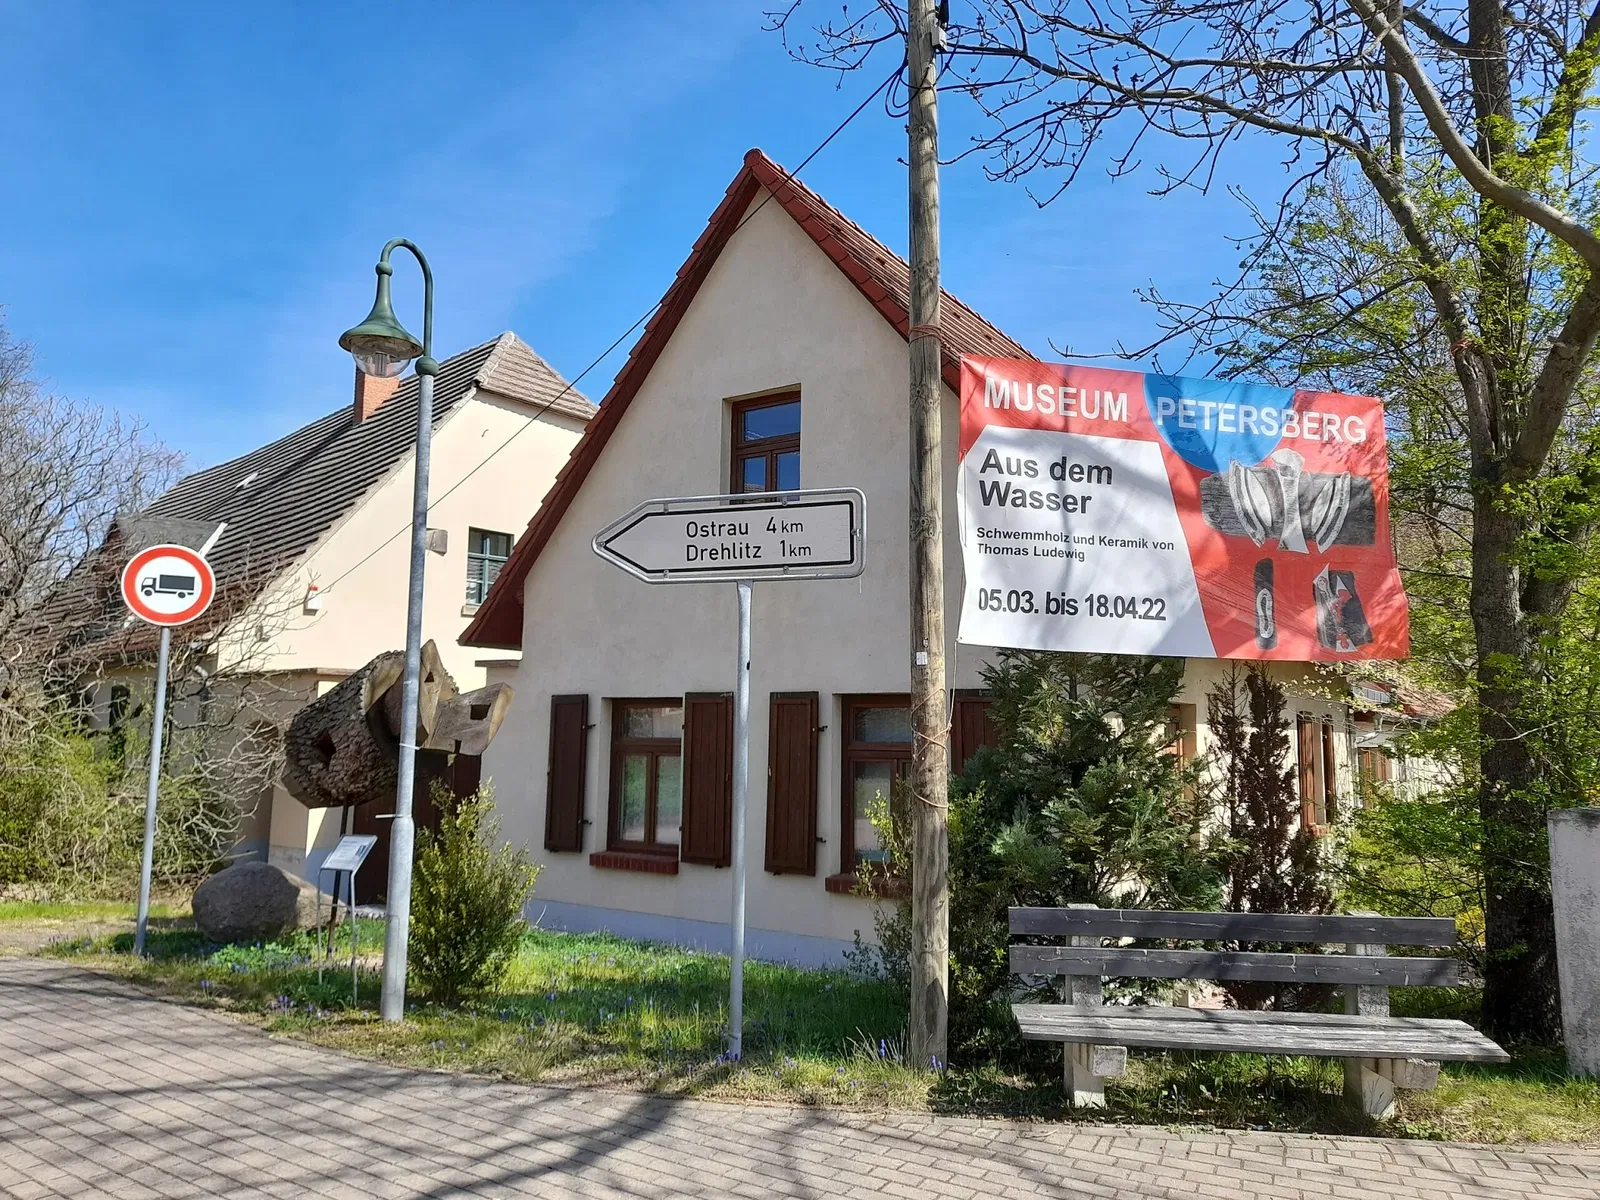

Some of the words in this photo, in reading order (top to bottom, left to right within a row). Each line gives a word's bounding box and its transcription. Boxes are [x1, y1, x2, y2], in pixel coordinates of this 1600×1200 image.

[984, 376, 1128, 423] MUSEUM
[1156, 396, 1367, 444] PETERSBERG
[979, 448, 1039, 479] Aus
[1049, 456, 1113, 485] dem
[979, 480, 1092, 514] Wasser
[686, 521, 749, 538] Ostrau
[976, 527, 1070, 543] Schwemmholz
[1073, 534, 1095, 545] und
[1098, 535, 1149, 549] Keramik
[1152, 541, 1175, 551] von
[686, 542, 762, 561] Drehlitz
[977, 543, 1029, 556] Thomas
[1033, 546, 1085, 562] Ludewig
[978, 587, 1039, 614] 05.03.
[1045, 591, 1079, 616] bis
[1084, 593, 1167, 621] 18.04.22
